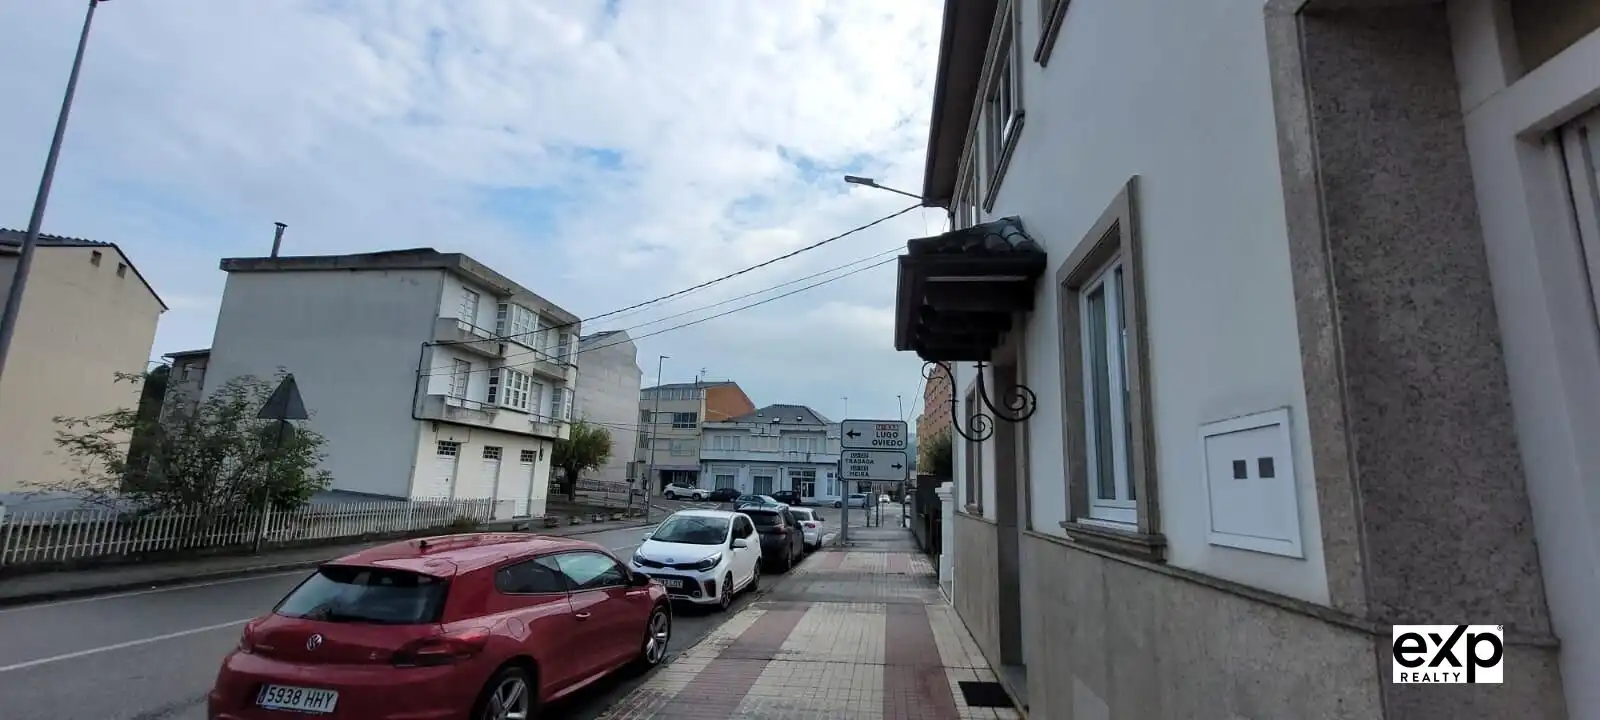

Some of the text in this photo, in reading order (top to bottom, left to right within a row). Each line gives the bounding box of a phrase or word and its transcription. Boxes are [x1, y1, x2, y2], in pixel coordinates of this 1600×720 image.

[872, 439, 903, 447] OVIEDO
[267, 687, 334, 709] 5938 HHY
